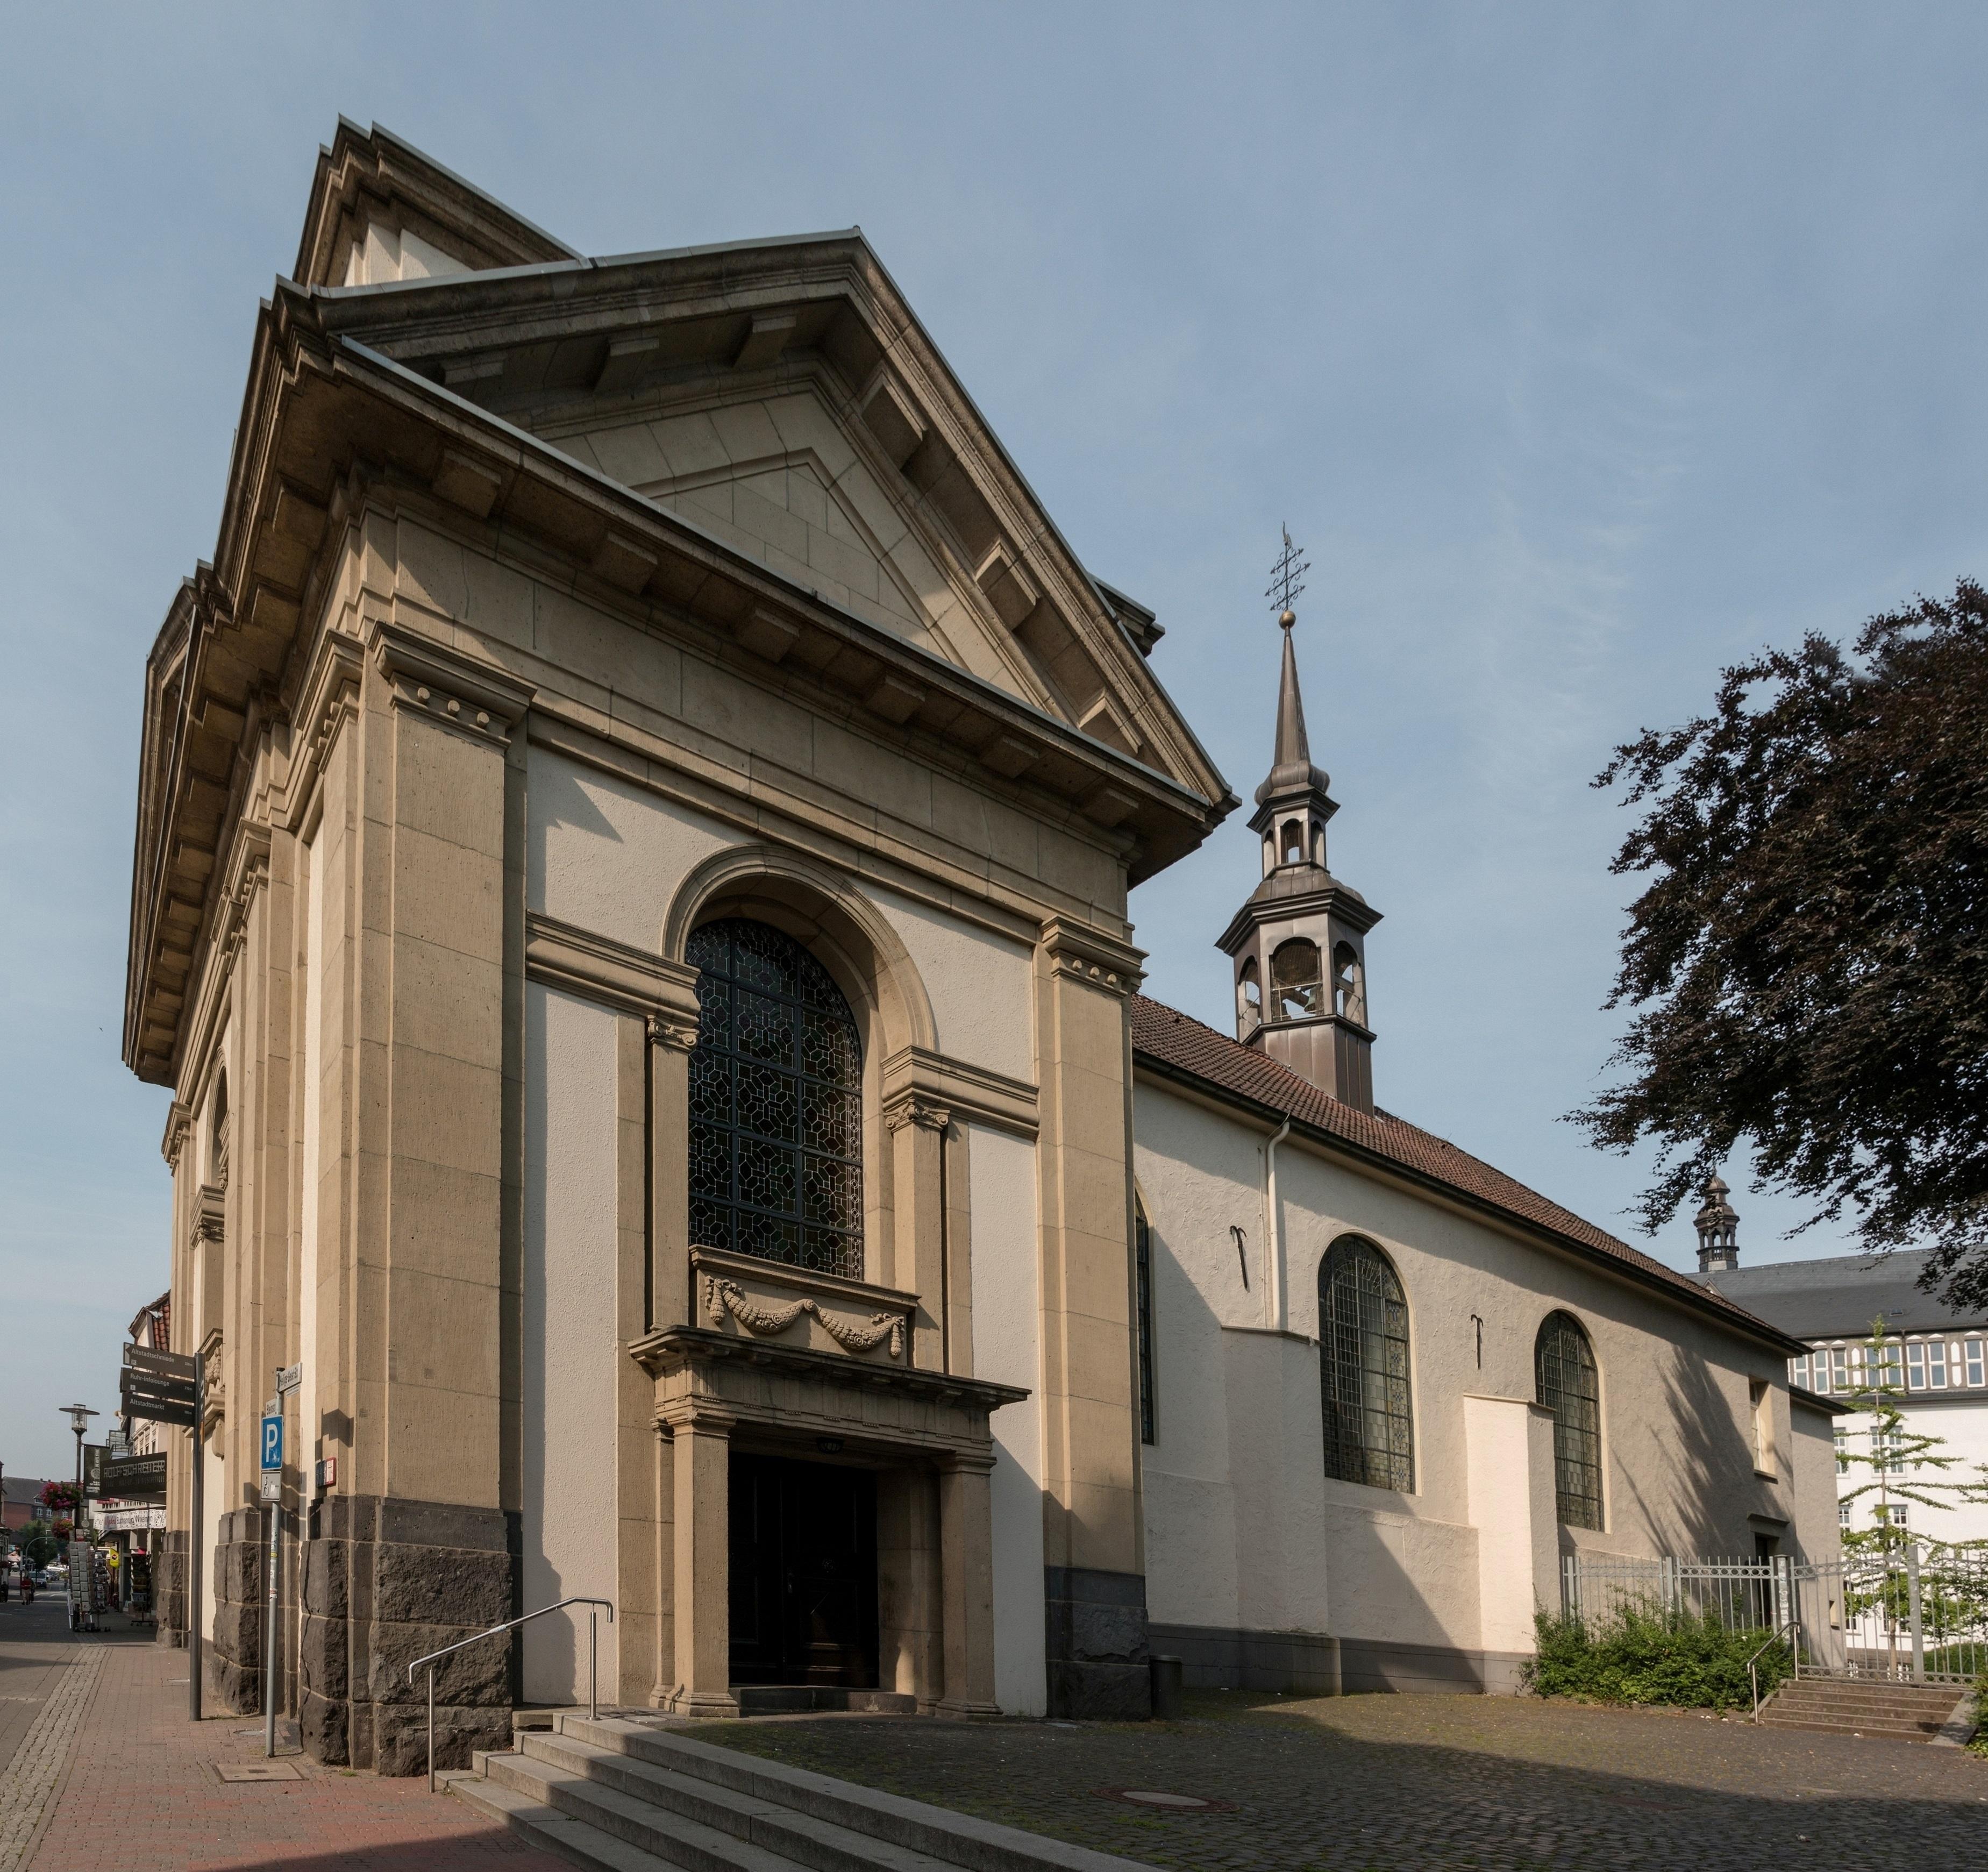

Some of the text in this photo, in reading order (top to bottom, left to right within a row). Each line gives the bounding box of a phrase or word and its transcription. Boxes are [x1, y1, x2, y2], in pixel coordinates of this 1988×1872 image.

[131, 1348, 175, 1363] Altstadtschmiede
[130, 1373, 170, 1386] Ruhr-Infolounge
[130, 1399, 165, 1410] Altstadtmarkt
[266, 1423, 278, 1463] P
